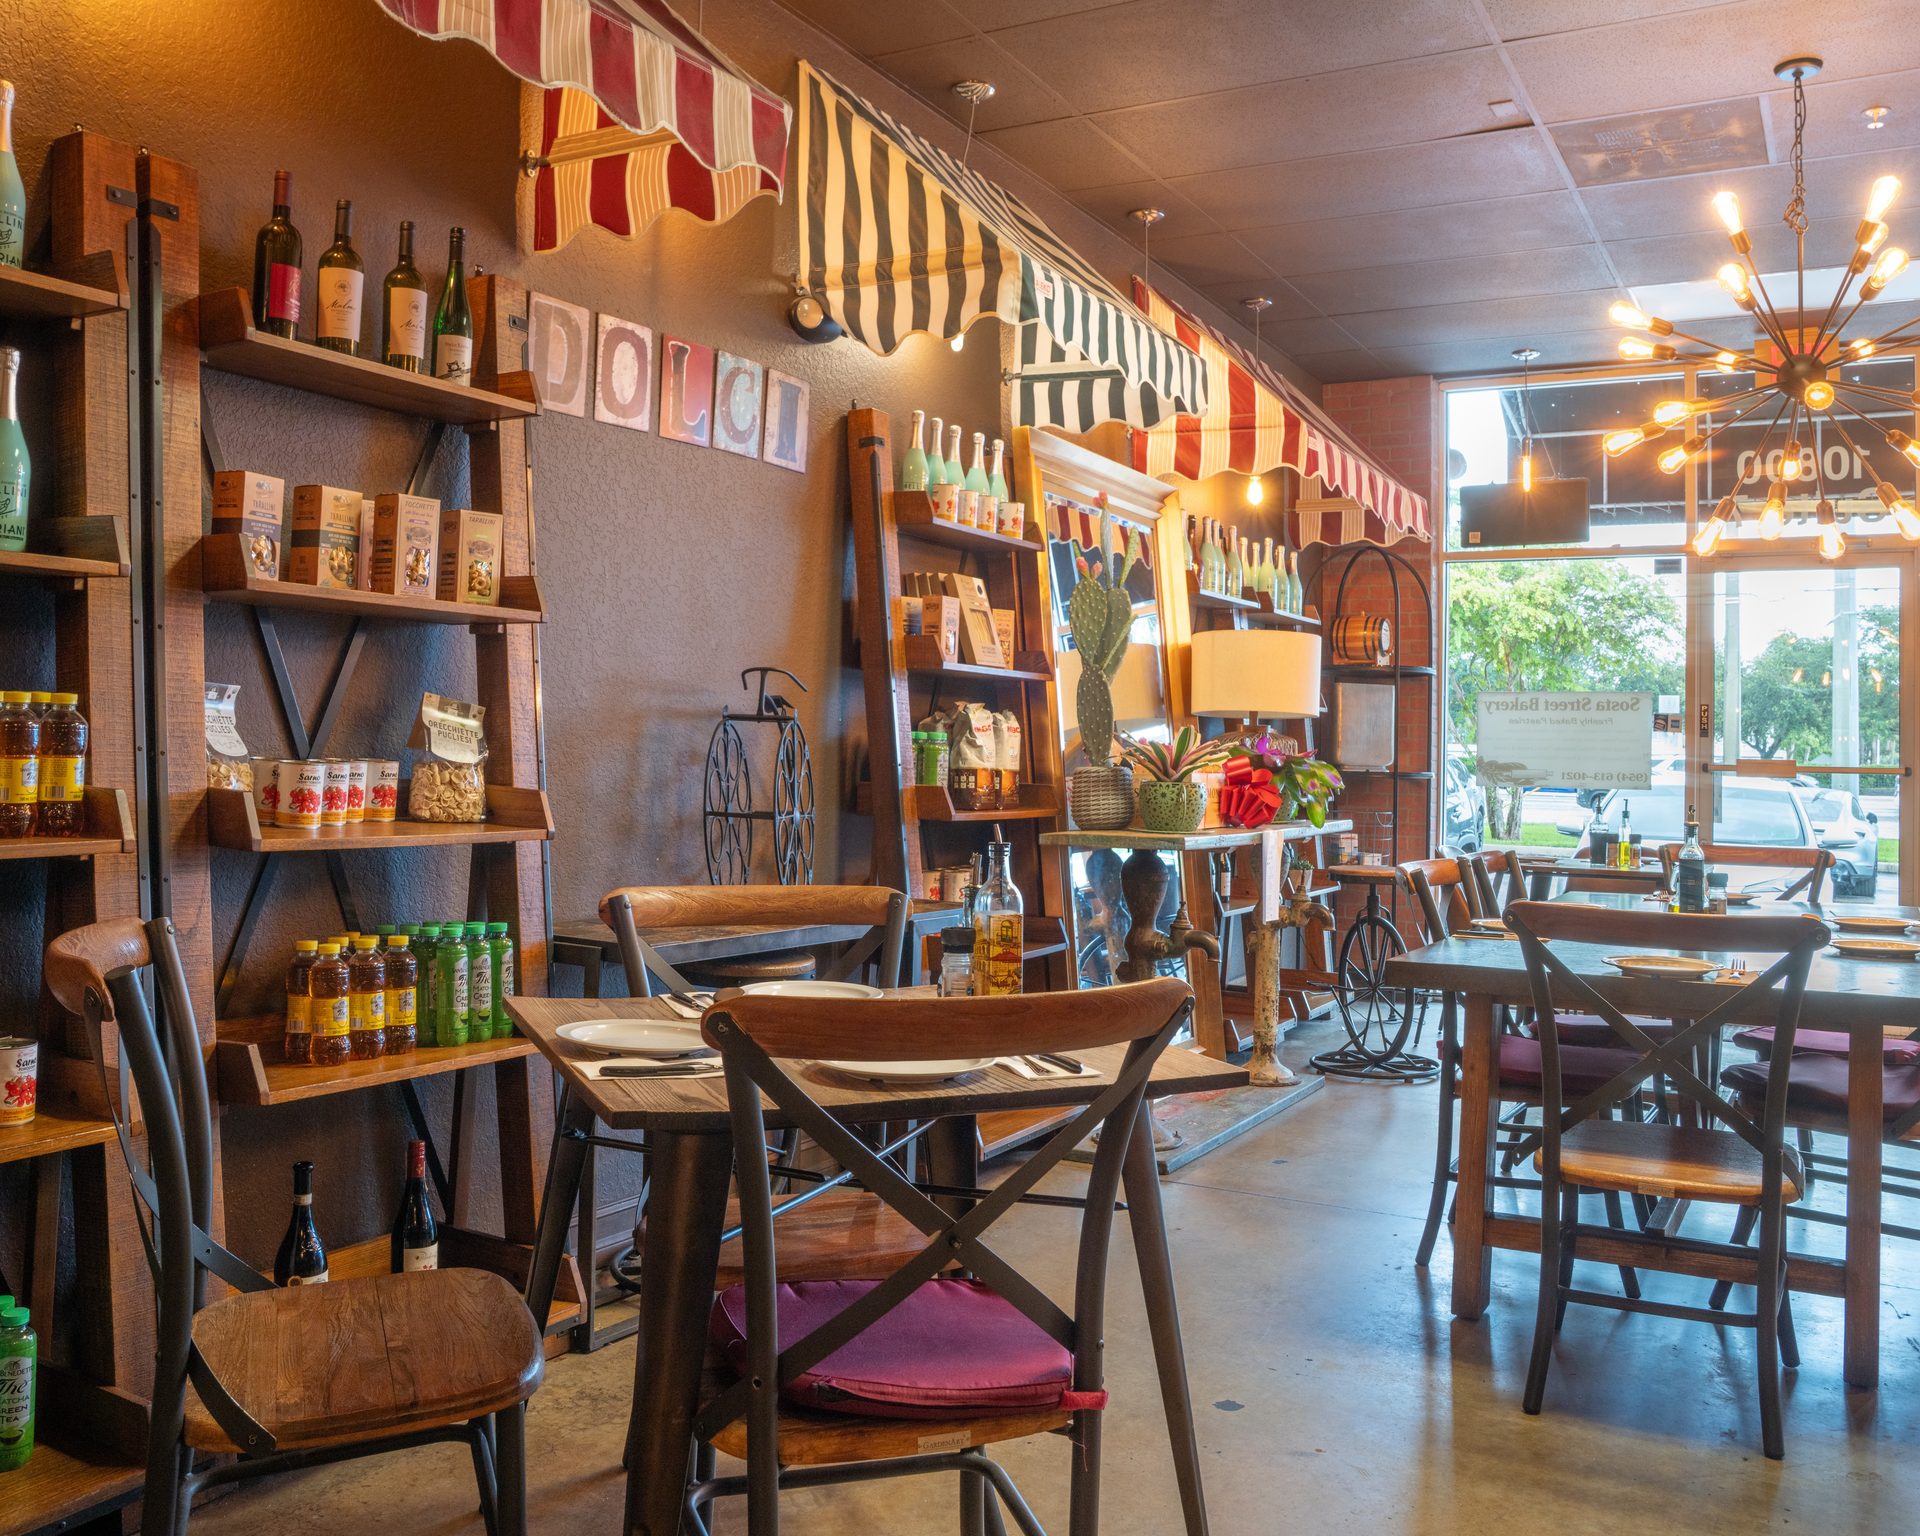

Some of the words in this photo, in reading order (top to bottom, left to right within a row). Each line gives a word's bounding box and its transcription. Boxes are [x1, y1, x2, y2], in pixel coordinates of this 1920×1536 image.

[534, 299, 802, 463] DOLCI
[1701, 705, 1709, 730] PUSH
[428, 719, 479, 739] ORECCHIETTE
[438, 730, 472, 744] PUGLIESI
[298, 772, 321, 782] Sarno
